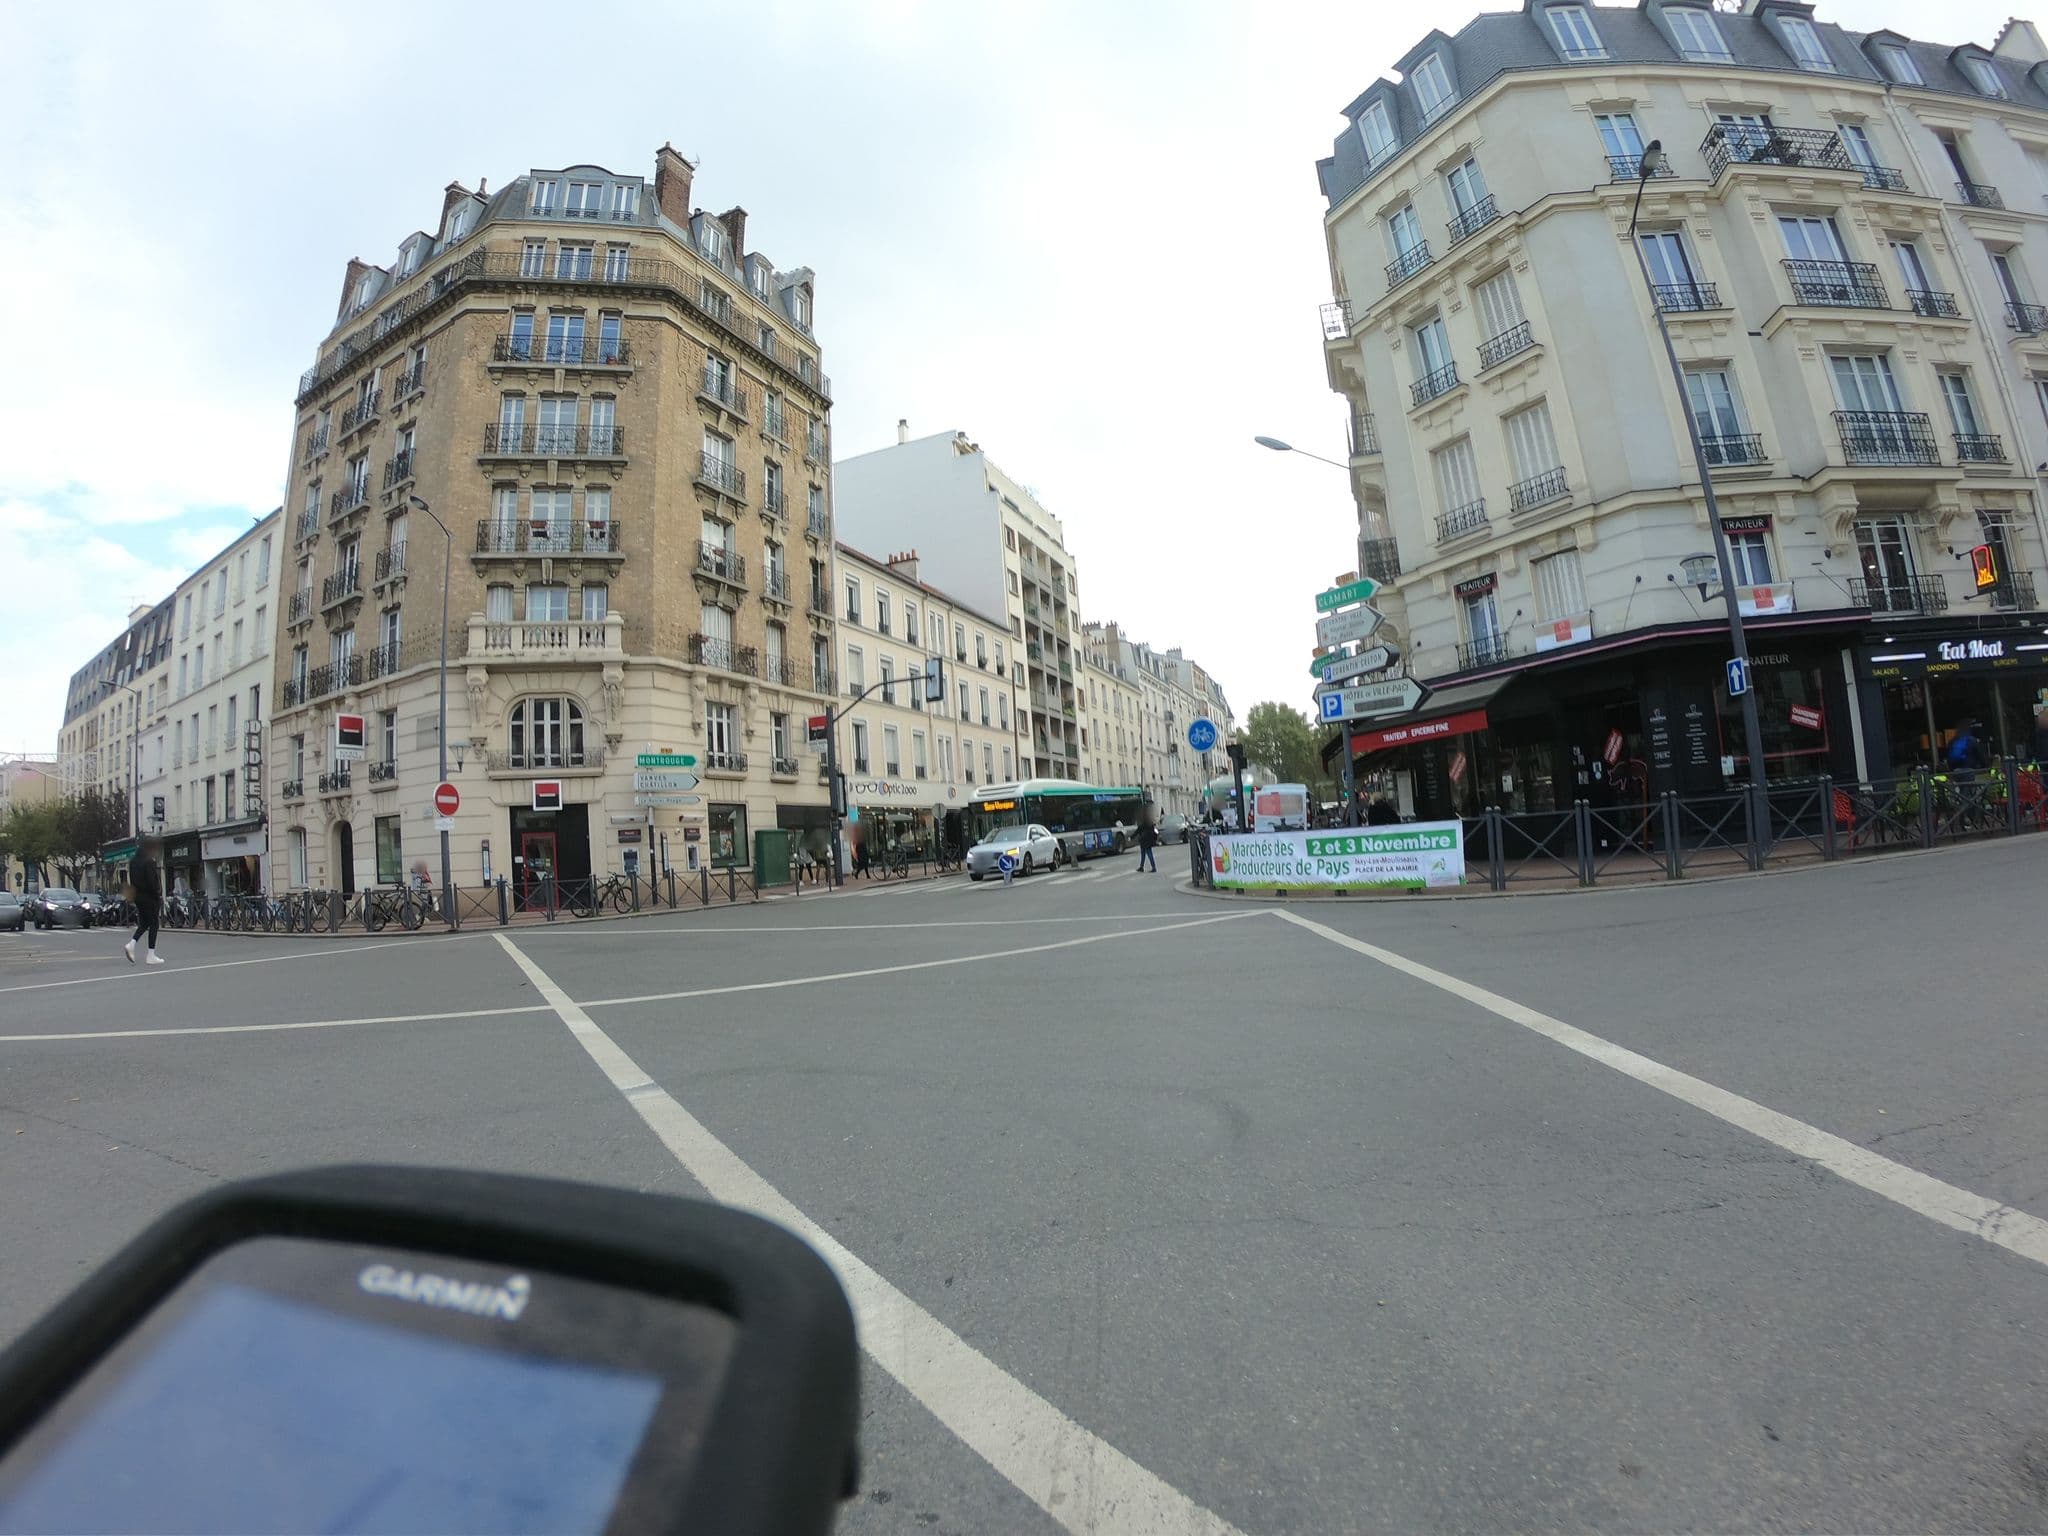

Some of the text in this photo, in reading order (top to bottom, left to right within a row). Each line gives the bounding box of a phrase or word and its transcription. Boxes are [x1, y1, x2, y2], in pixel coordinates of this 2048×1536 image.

[1724, 519, 1765, 530] TRAITEUR
[1460, 576, 1491, 593] TRAITEUR
[1318, 587, 1358, 608] CLAMART
[1938, 640, 2004, 660] Eat Meat
[1749, 654, 1790, 666] RAITEUR
[1872, 667, 1900, 676] SALADES
[1326, 697, 1338, 716] P
[1383, 730, 1408, 742] TRAITEUR
[1411, 722, 1449, 738] EPICERIE FINE
[639, 756, 685, 765] MONTROUGE
[882, 781, 917, 797] Optic 2000
[1231, 839, 1294, 857] Marchés des
[1312, 833, 1451, 855] 2 et 3 Novembre
[1233, 858, 1350, 879] Producteurs de Pays
[358, 1263, 531, 1321] GARMIN
